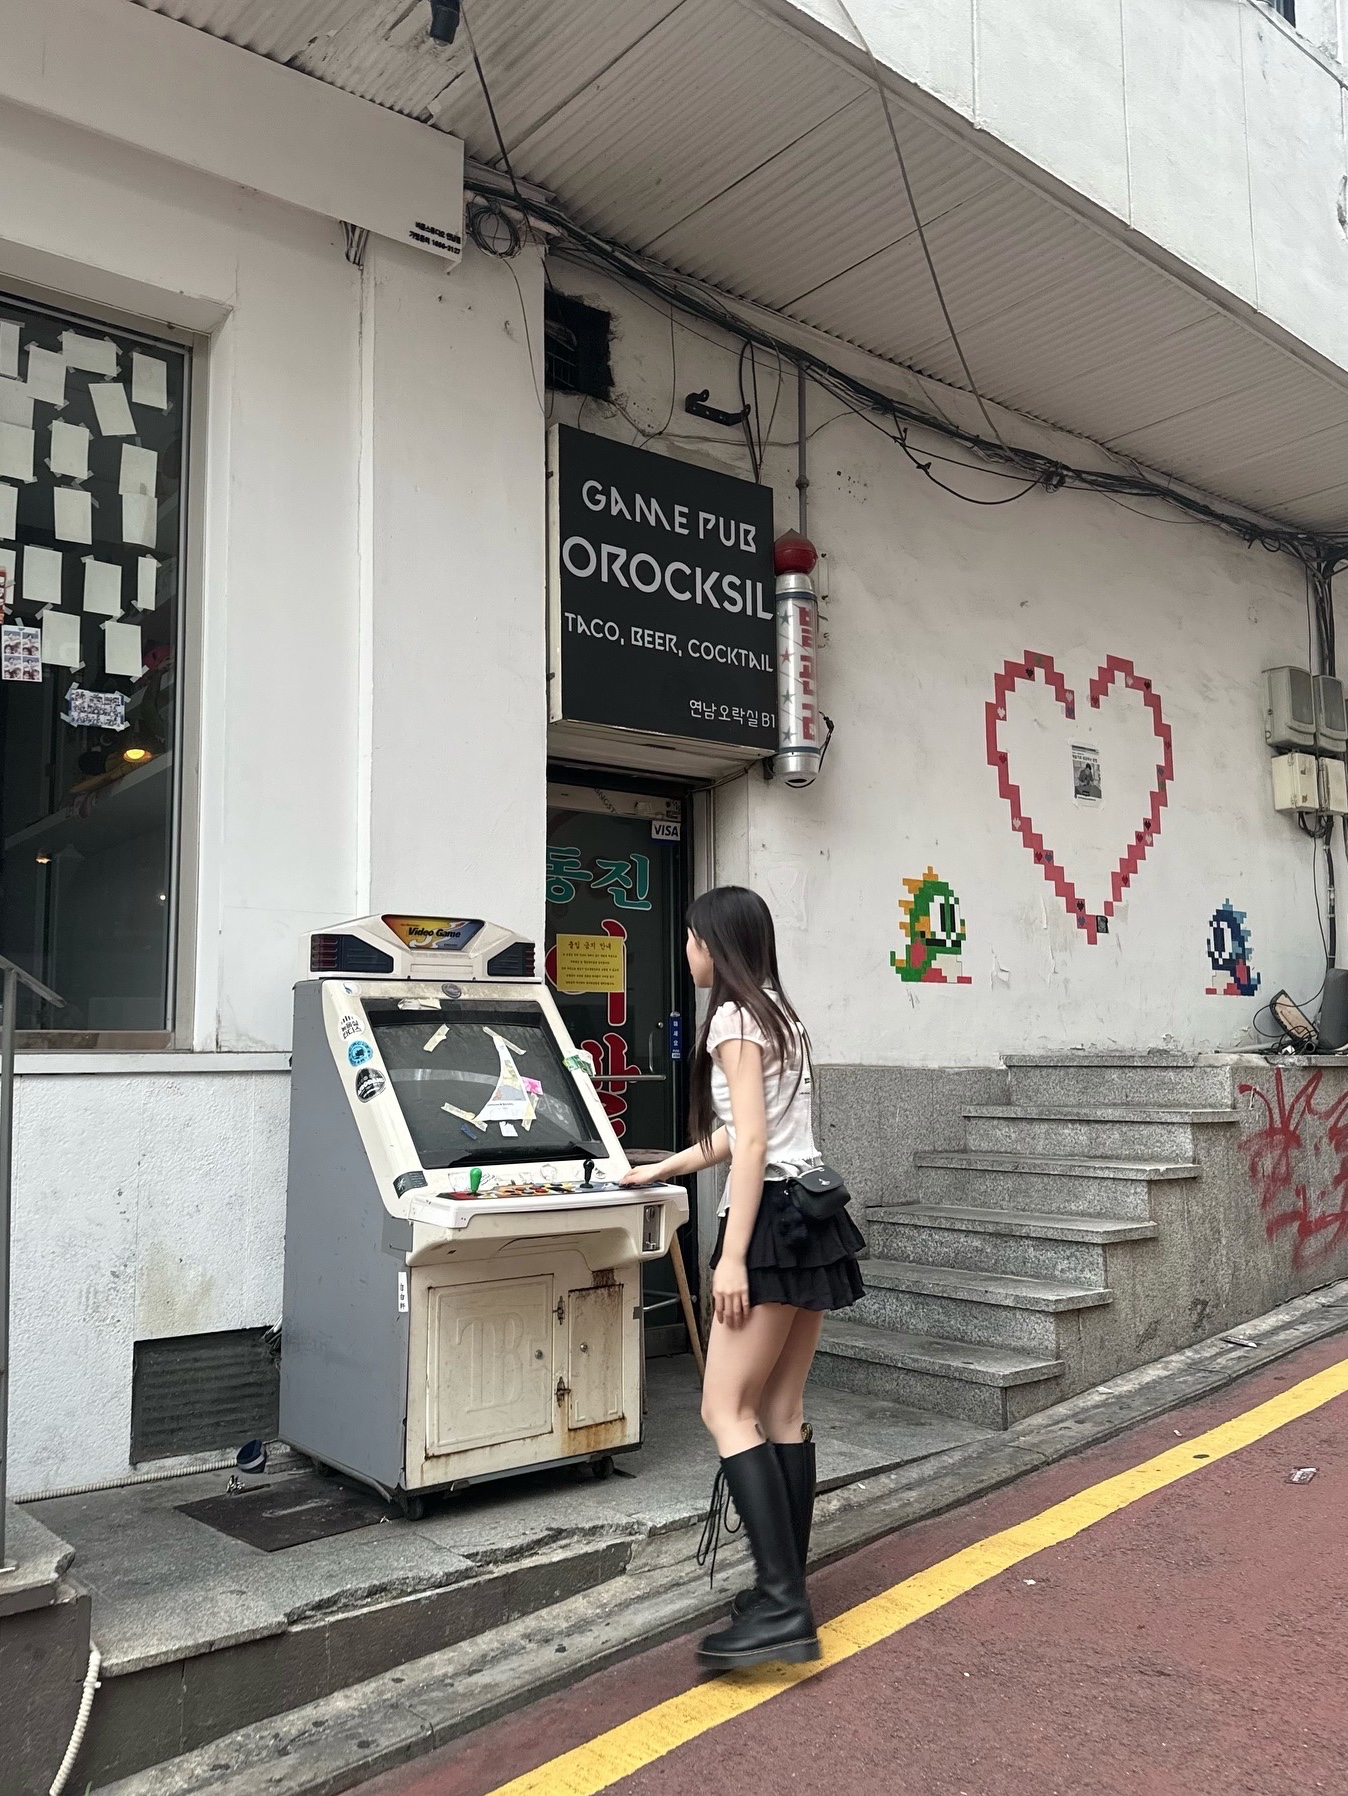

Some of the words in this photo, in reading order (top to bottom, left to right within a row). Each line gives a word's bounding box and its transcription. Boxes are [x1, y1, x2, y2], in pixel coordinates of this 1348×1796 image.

[582, 480, 690, 535] GAME
[699, 511, 757, 553] PUB
[562, 536, 774, 620] OROCKSIL
[564, 612, 624, 645] TACO,
[631, 626, 683, 657] BEER,
[687, 639, 773, 673] COCKTAIL
[654, 825, 678, 838] VISA
[409, 927, 434, 937] Video
[436, 928, 461, 938] Game
